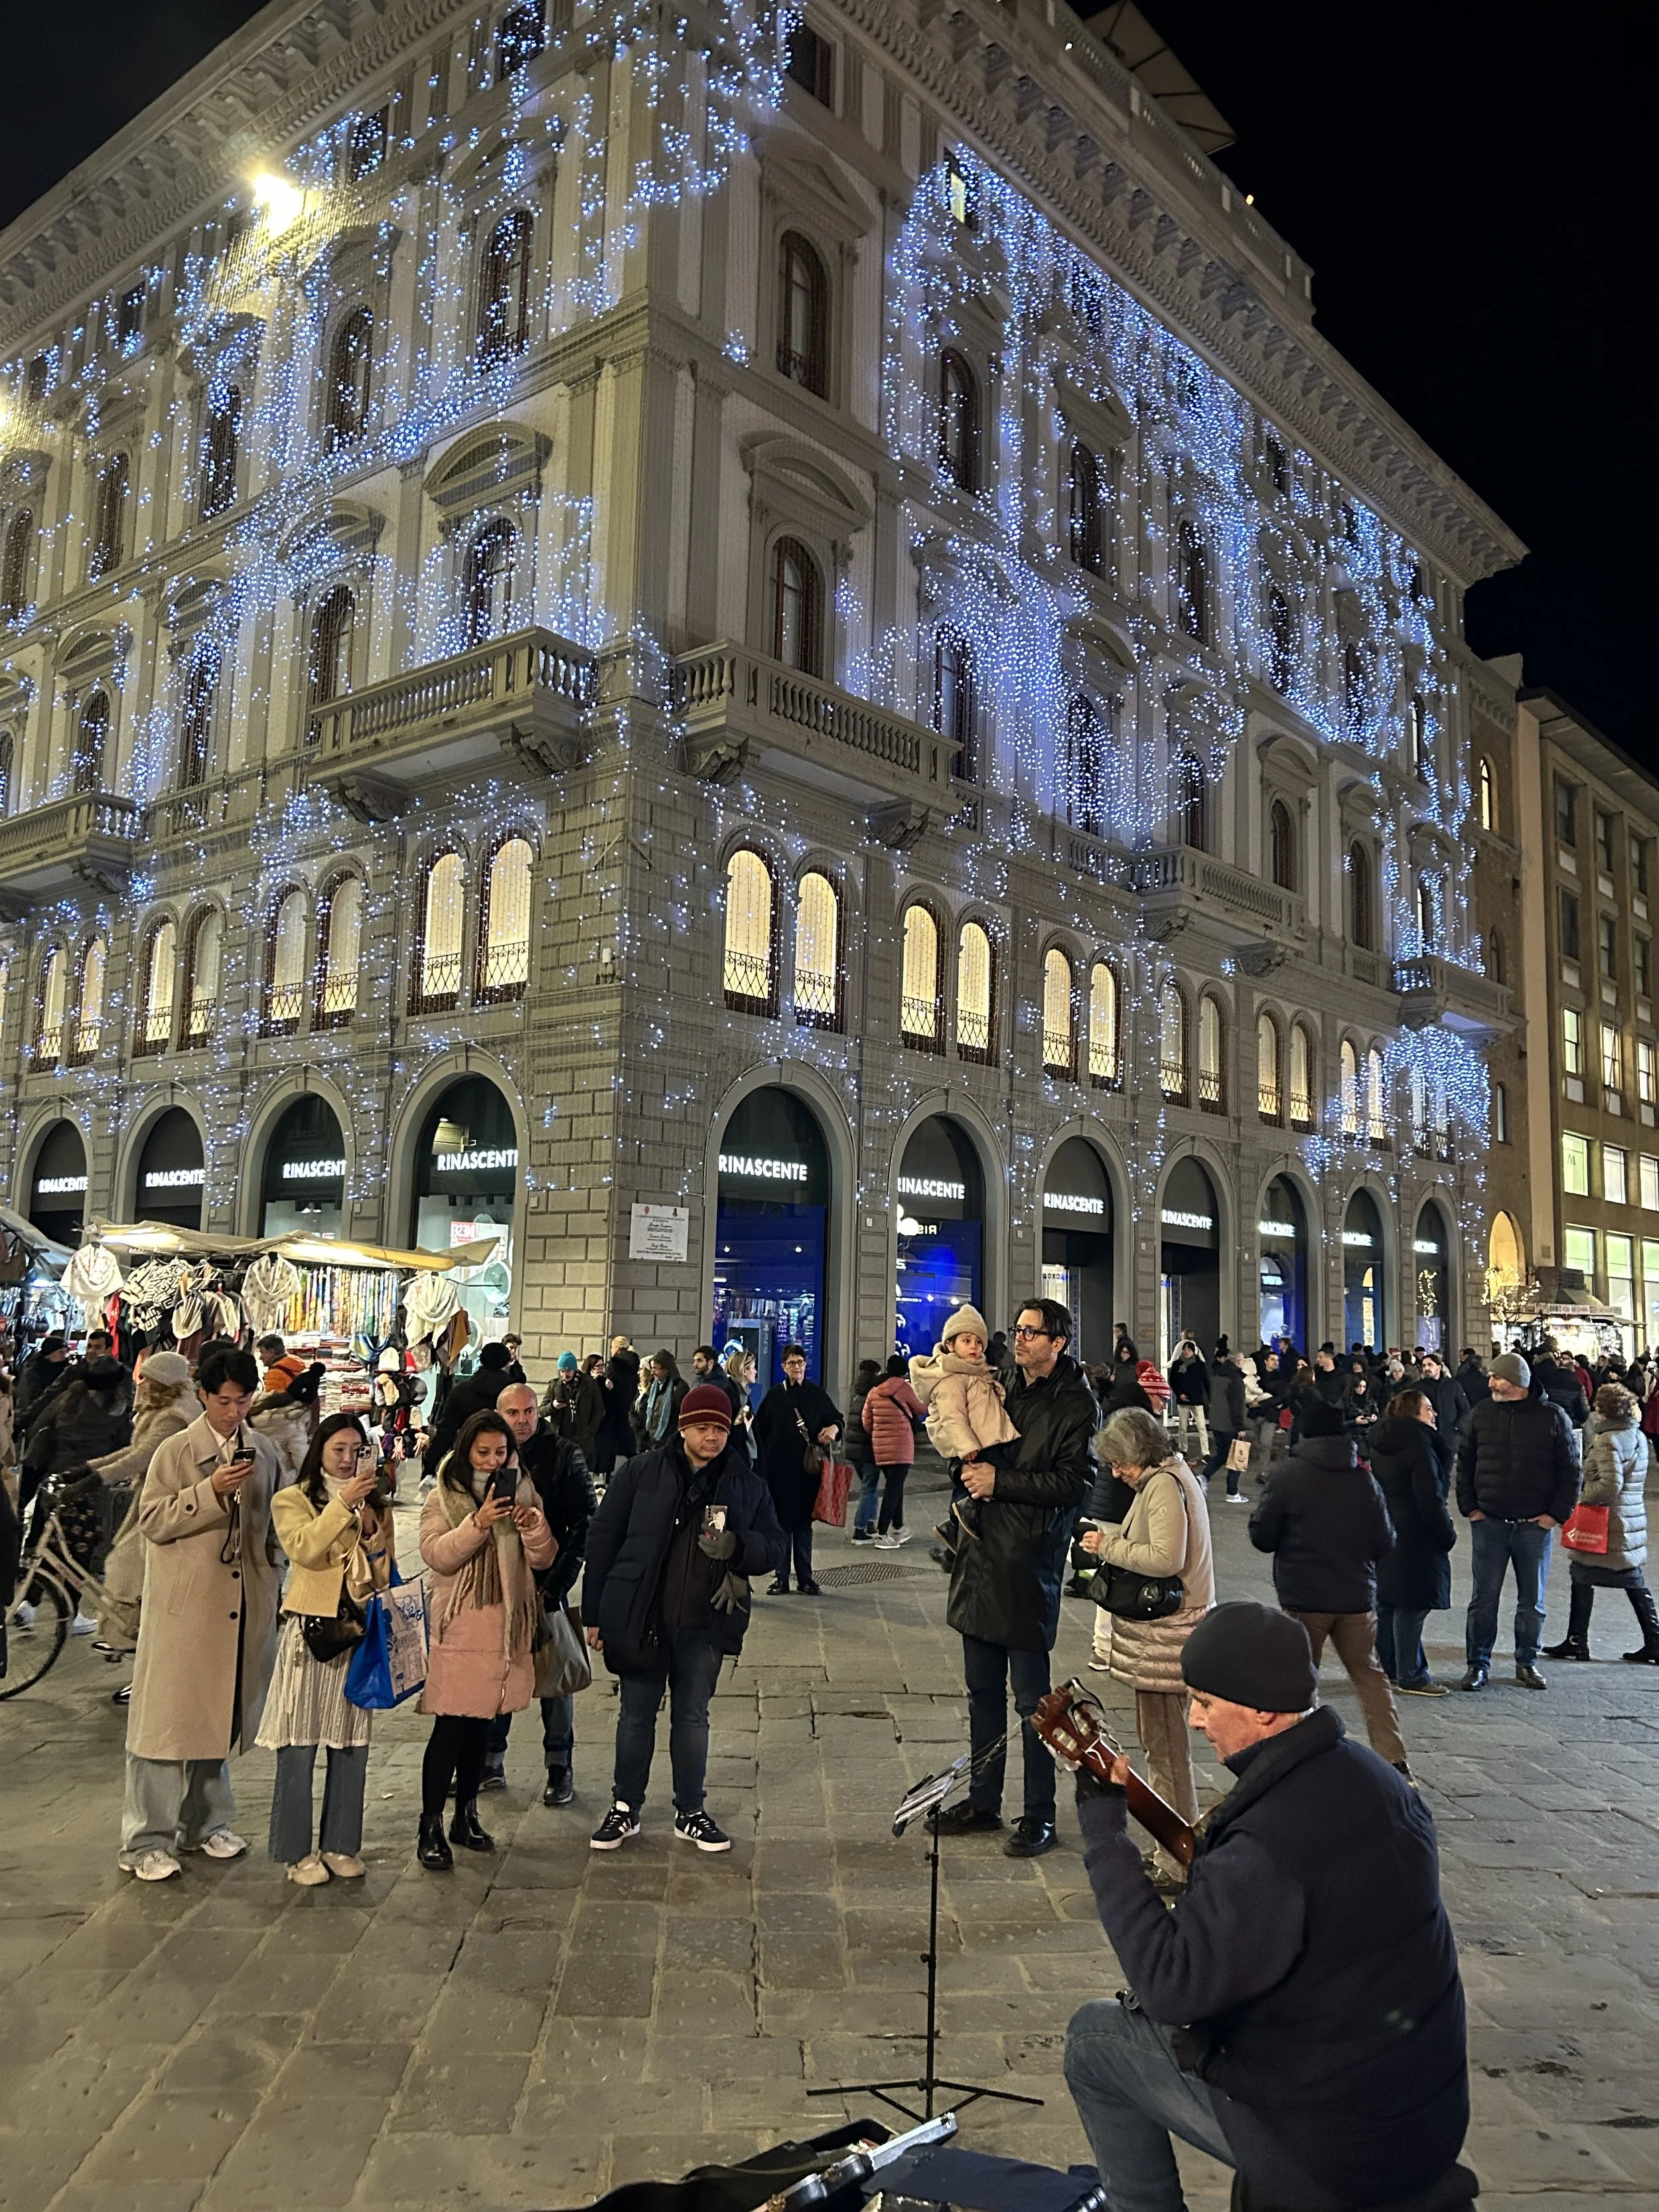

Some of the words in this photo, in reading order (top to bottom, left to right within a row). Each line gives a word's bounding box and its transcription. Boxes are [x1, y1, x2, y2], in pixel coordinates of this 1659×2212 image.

[146, 1169, 206, 1187] RINASCENTE
[719, 1155, 807, 1181] RINASCENTE
[38, 1176, 89, 1193] RINASCENTE
[1044, 1193, 1104, 1214] RINASCENTE
[1161, 1209, 1212, 1229] RINASCENTE
